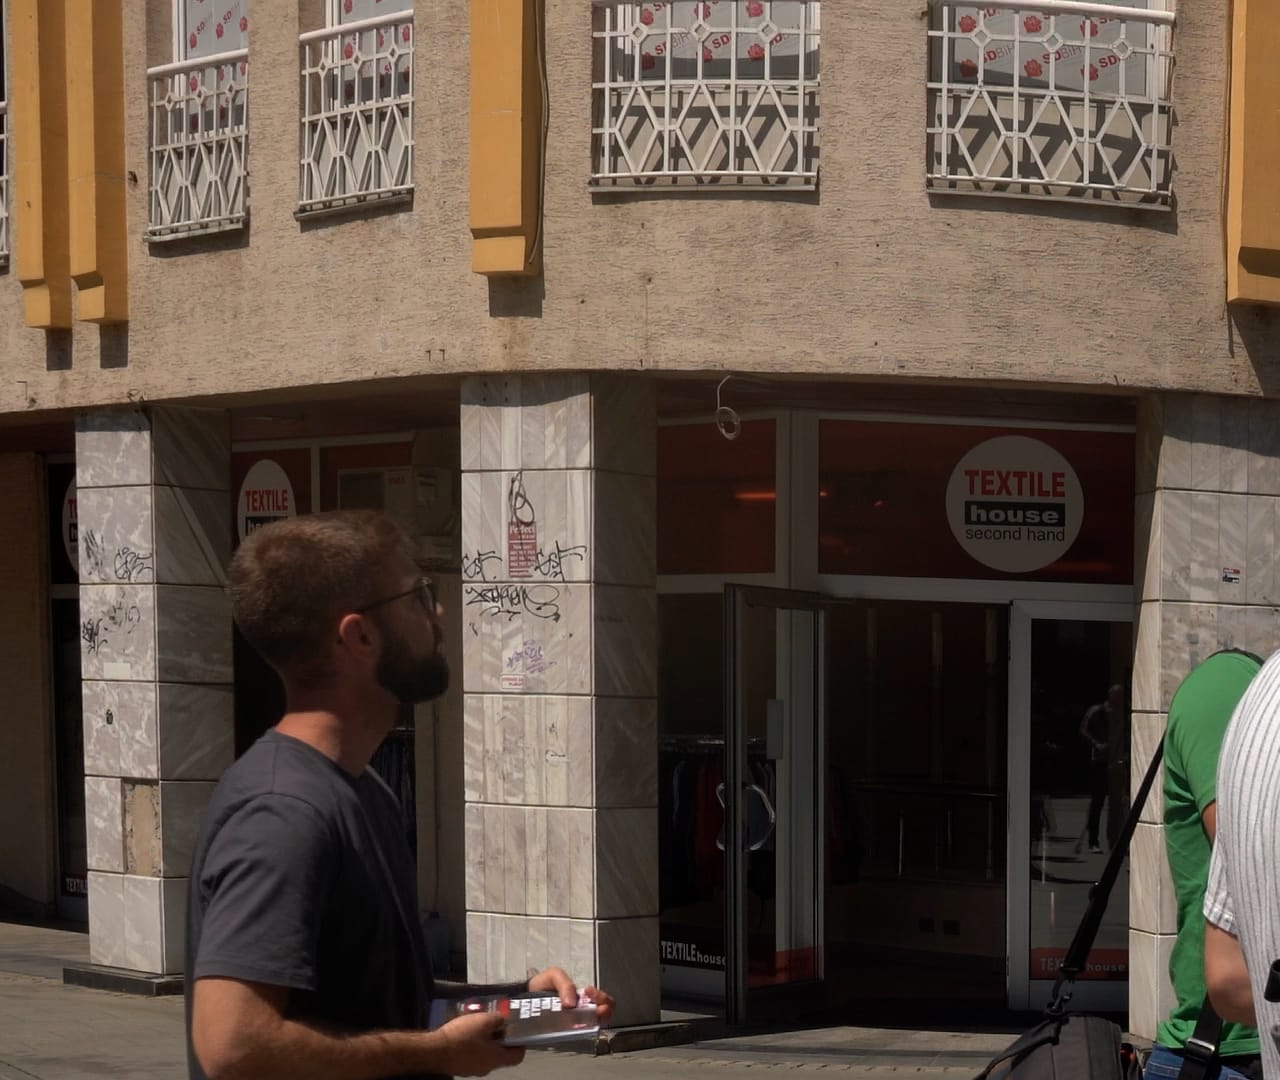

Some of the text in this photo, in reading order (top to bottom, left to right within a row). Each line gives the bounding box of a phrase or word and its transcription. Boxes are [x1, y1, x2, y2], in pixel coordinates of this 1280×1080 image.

[964, 469, 1066, 498] TEXTILE
[245, 488, 289, 513] TEXTILE
[970, 504, 1060, 524] house
[965, 527, 1066, 542] second hand
[661, 940, 697, 962] TEXTILE
